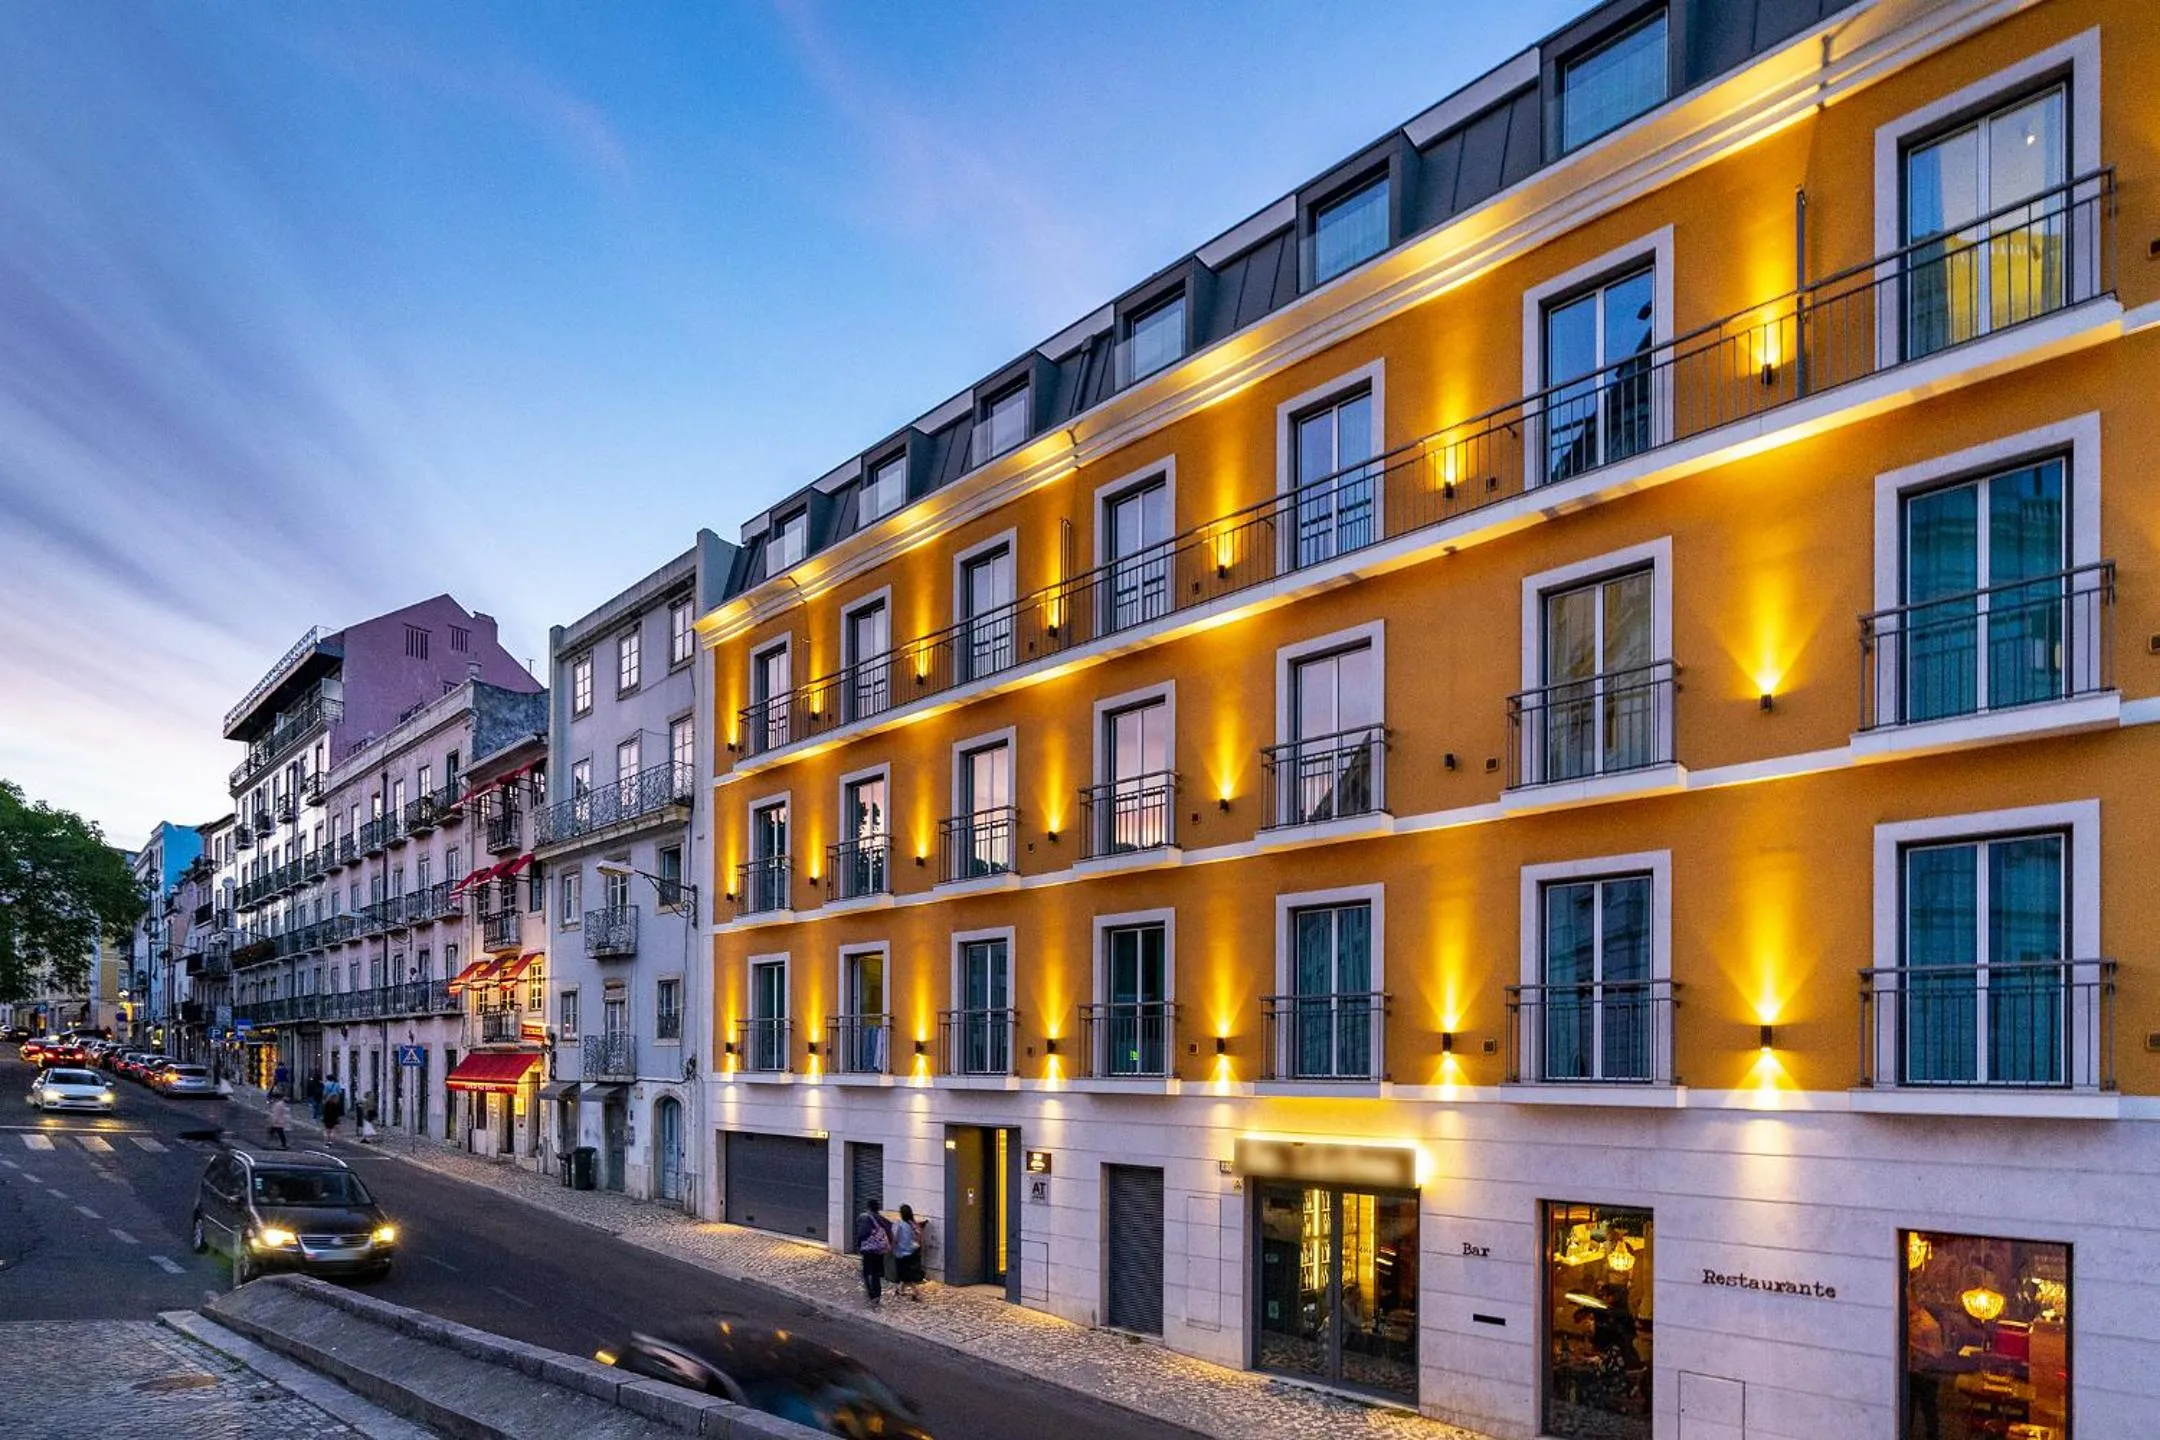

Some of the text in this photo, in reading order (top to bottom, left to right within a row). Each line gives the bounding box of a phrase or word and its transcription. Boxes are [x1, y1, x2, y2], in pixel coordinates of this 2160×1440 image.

[212, 1029, 221, 1038] P
[1032, 1182, 1046, 1195] AT
[1462, 1242, 1490, 1256] Bar
[1702, 1269, 1836, 1298] Restaurante
